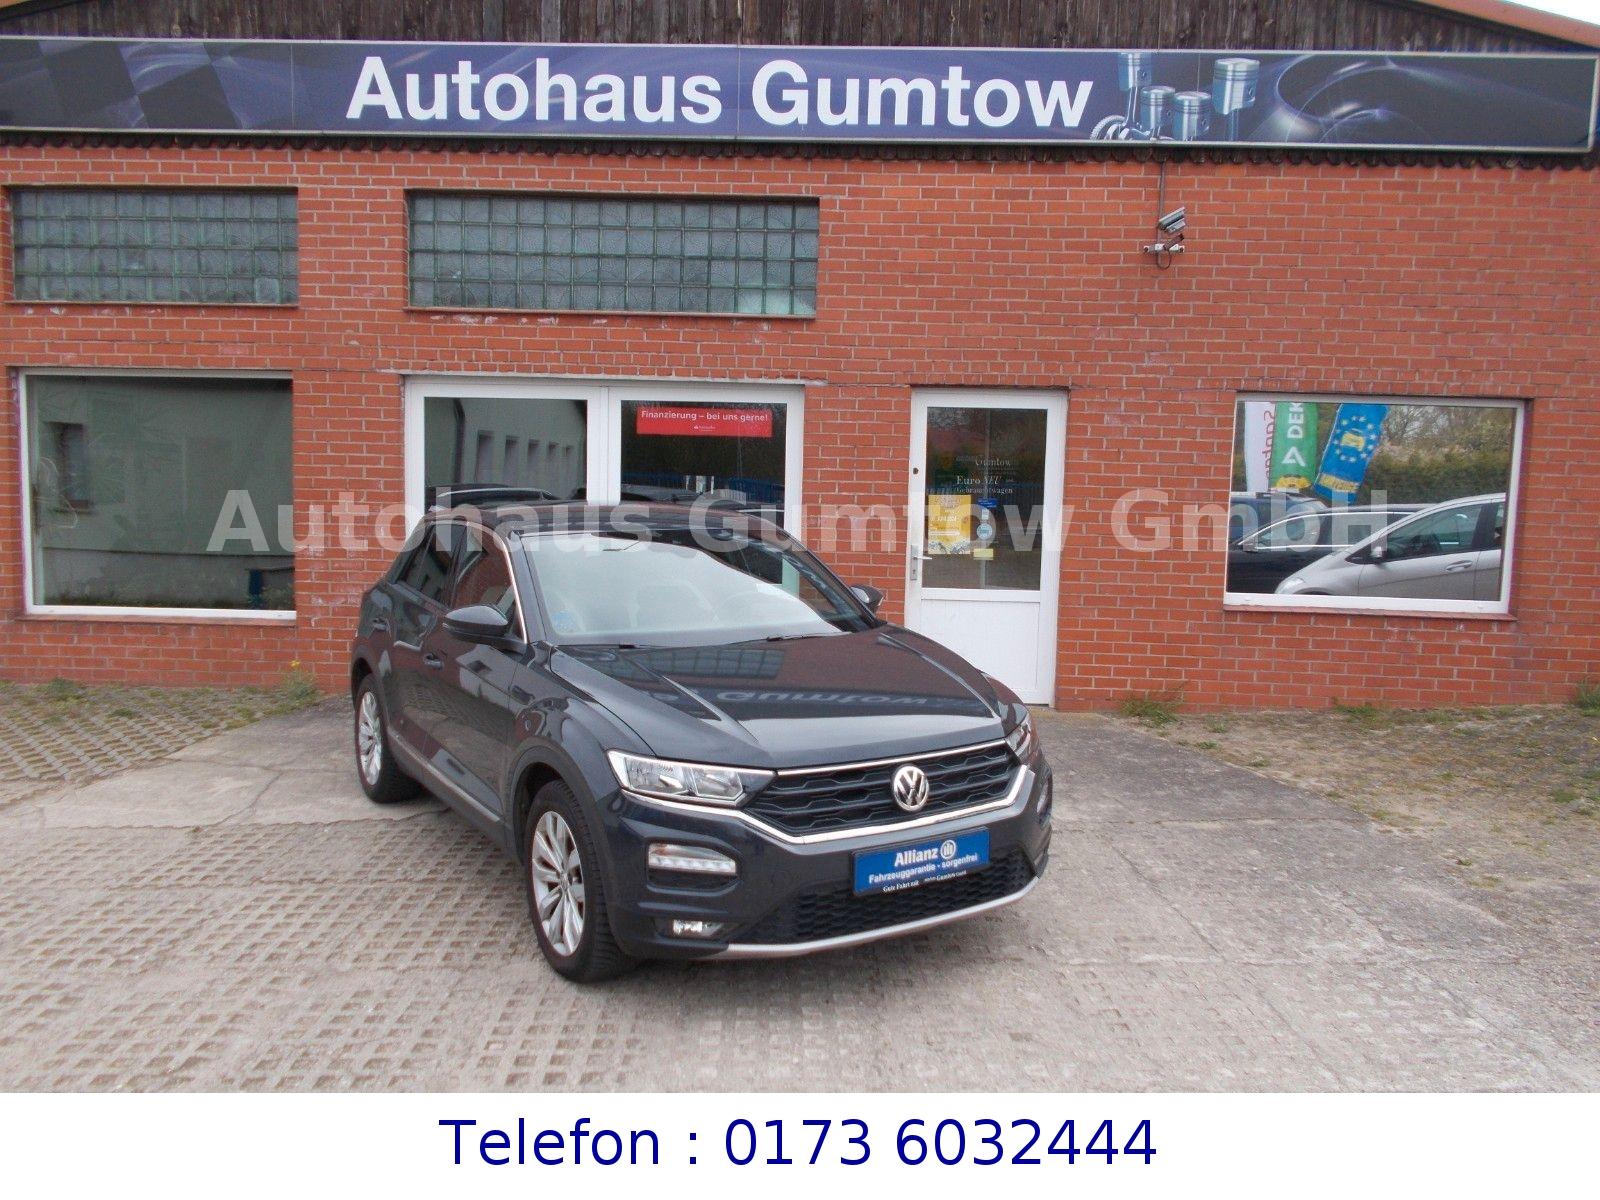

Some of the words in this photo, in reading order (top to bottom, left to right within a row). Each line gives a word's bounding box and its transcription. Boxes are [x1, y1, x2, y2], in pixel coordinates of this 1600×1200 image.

[346, 56, 722, 124] Autohaus
[752, 59, 1101, 133] Gumtow
[641, 410, 697, 421] Finanzierung
[706, 412, 720, 420] bei
[740, 414, 768, 423] gerne!
[956, 475, 981, 485] Euro
[895, 848, 939, 867] Allianz
[868, 863, 936, 884] Fahrzeuggarantie
[942, 853, 978, 868] sorgenfrei
